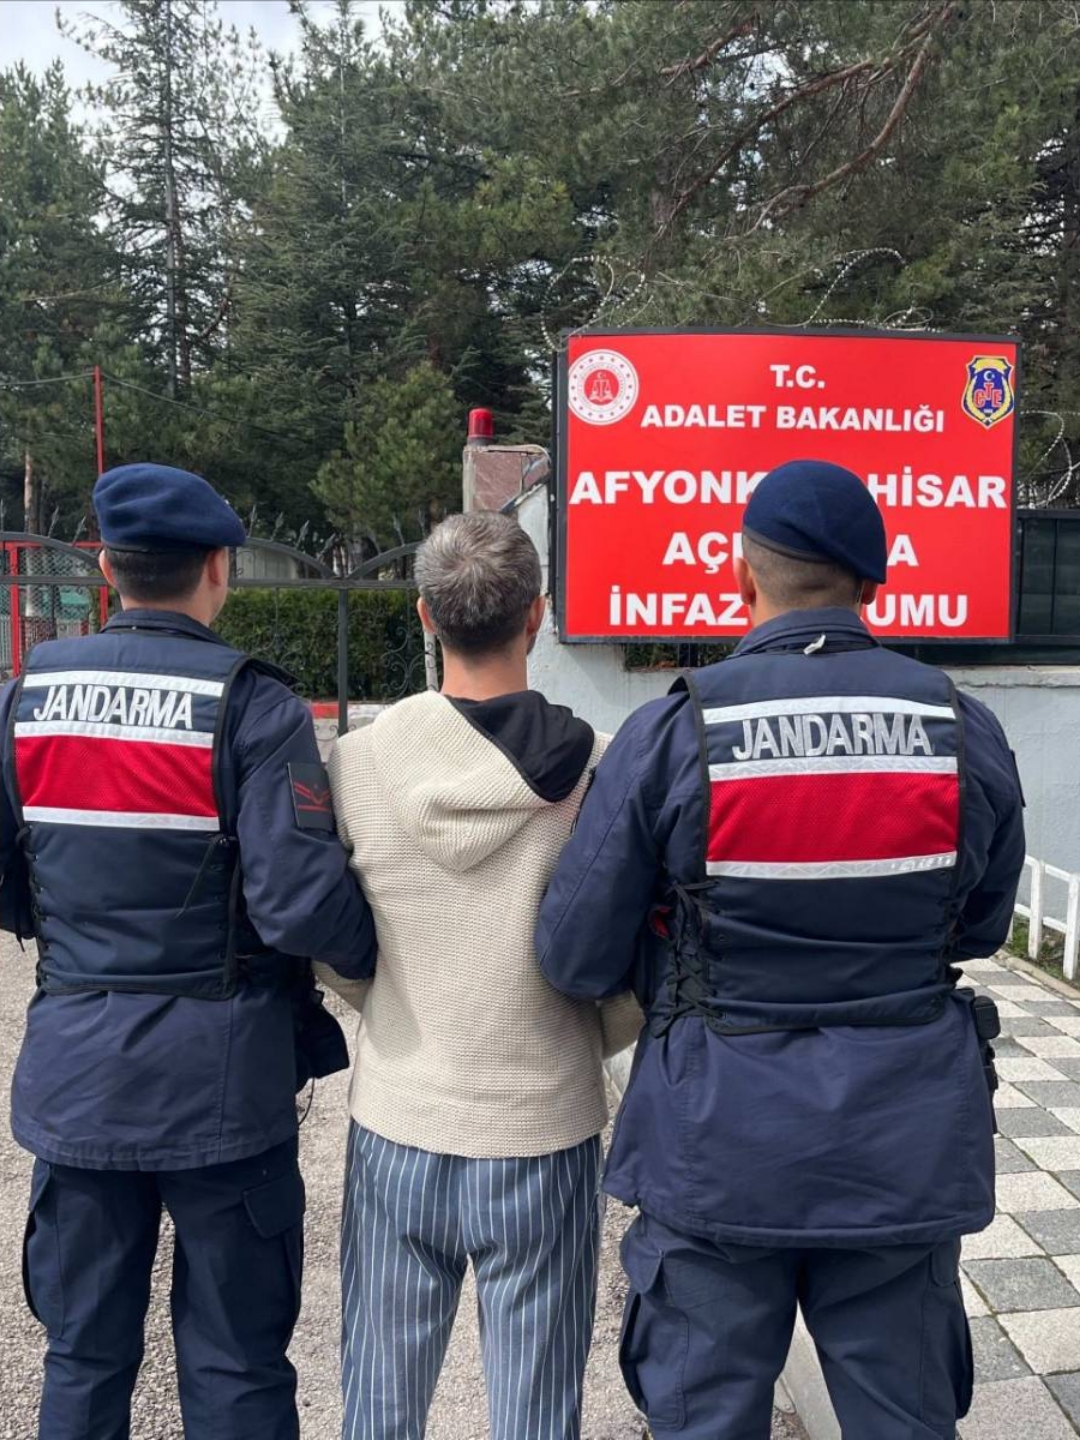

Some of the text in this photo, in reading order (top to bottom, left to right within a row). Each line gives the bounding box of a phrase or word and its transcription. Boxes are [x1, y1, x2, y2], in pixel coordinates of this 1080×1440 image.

[770, 364, 825, 389] T.C.
[974, 382, 1003, 408] CTE
[640, 405, 944, 432] ADALET BAKANLIĞI
[569, 466, 1007, 508] AFYONKHİSAR
[662, 531, 743, 574] AÇI
[610, 585, 748, 626] İNFAZ
[33, 684, 193, 729] JANDARMA
[732, 712, 933, 760] JANDARMA
